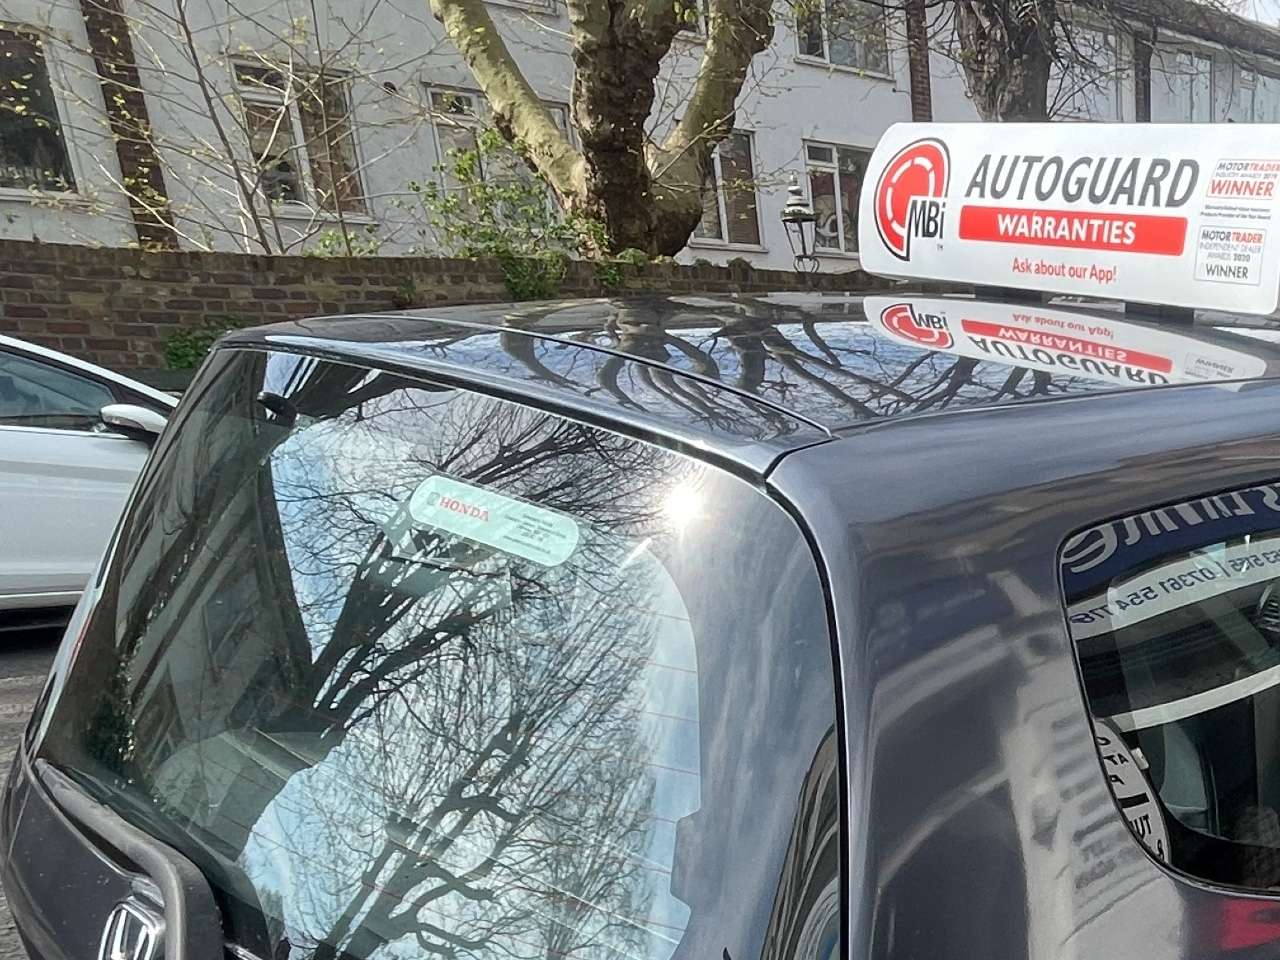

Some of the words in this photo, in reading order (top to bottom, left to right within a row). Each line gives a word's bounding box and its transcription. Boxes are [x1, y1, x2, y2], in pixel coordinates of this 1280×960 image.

[964, 153, 1200, 208] AUTOGUARD
[1211, 179, 1275, 197] WINNER
[911, 199, 946, 239] MBi
[997, 213, 1137, 245] WARRANTIES
[1012, 257, 1033, 273] Ask
[1034, 259, 1066, 277] about
[1069, 267, 1088, 280] our
[1089, 263, 1117, 284] App!
[1205, 263, 1249, 279] WINNER
[439, 498, 490, 522] HONDA
